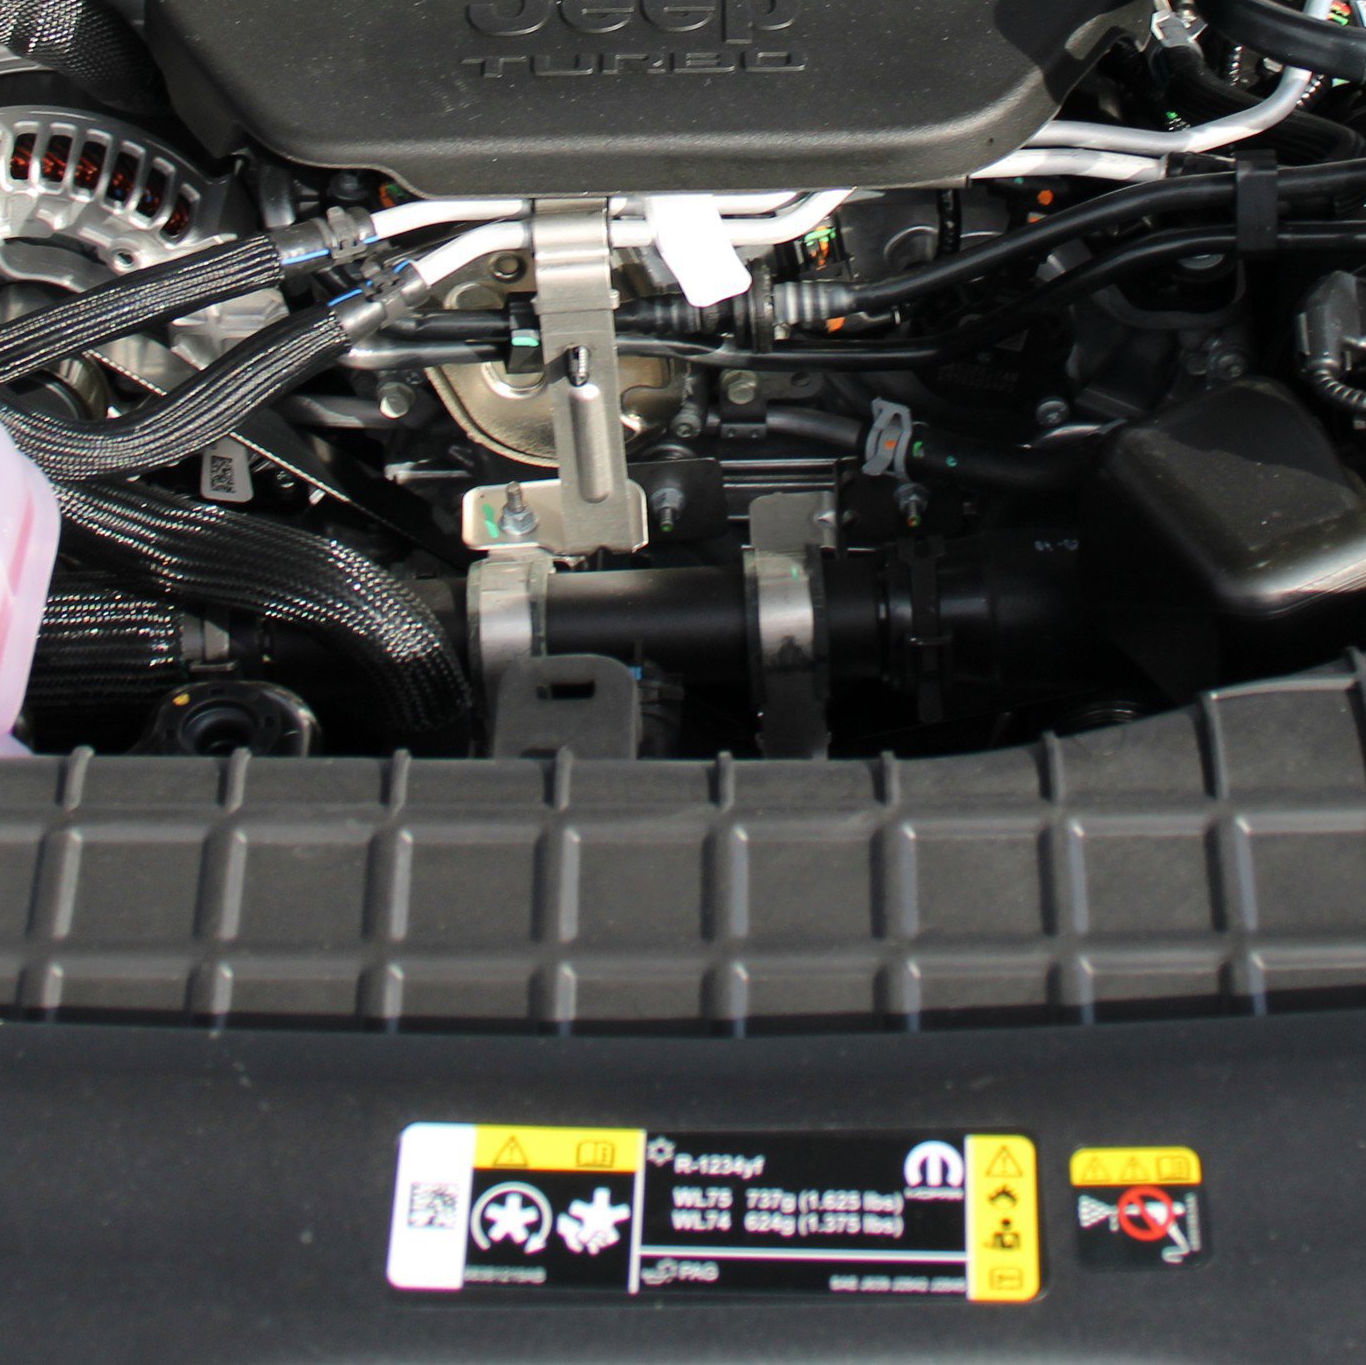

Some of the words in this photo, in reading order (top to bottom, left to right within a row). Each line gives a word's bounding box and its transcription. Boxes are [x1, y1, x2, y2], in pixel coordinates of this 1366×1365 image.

[461, 50, 808, 79] TURBO
[673, 1152, 766, 1180] R-1234yf
[672, 1186, 733, 1209] WL75
[745, 1188, 796, 1214] 737g
[798, 1189, 861, 1214] (1.625
[862, 1190, 905, 1216] lbs)
[671, 1209, 732, 1231] WL74
[744, 1210, 796, 1237] 624g
[797, 1211, 861, 1237] (1.375
[862, 1213, 905, 1239] lbs)
